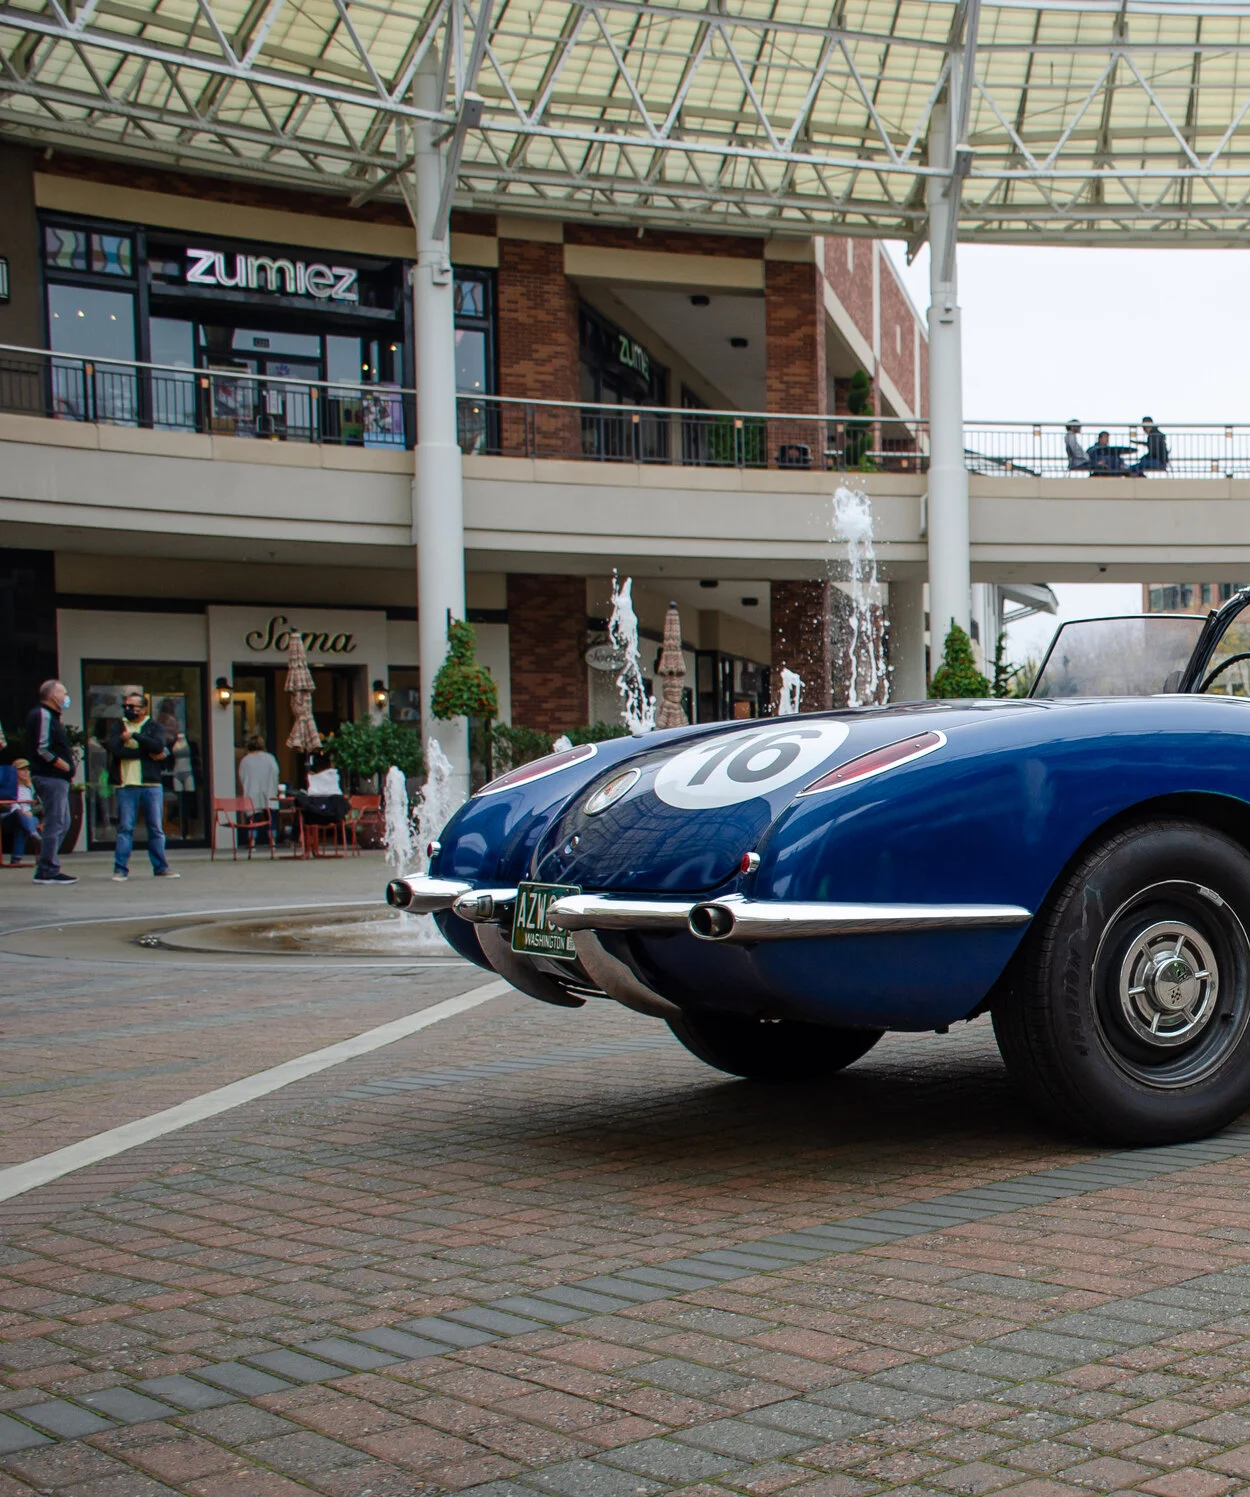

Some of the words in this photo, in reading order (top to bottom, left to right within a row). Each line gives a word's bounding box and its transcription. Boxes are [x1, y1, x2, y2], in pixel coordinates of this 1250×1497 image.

[186, 248, 358, 301] zumiez
[245, 615, 357, 653] Soma
[687, 729, 822, 786] 16
[524, 932, 565, 951] WASHINGTON
